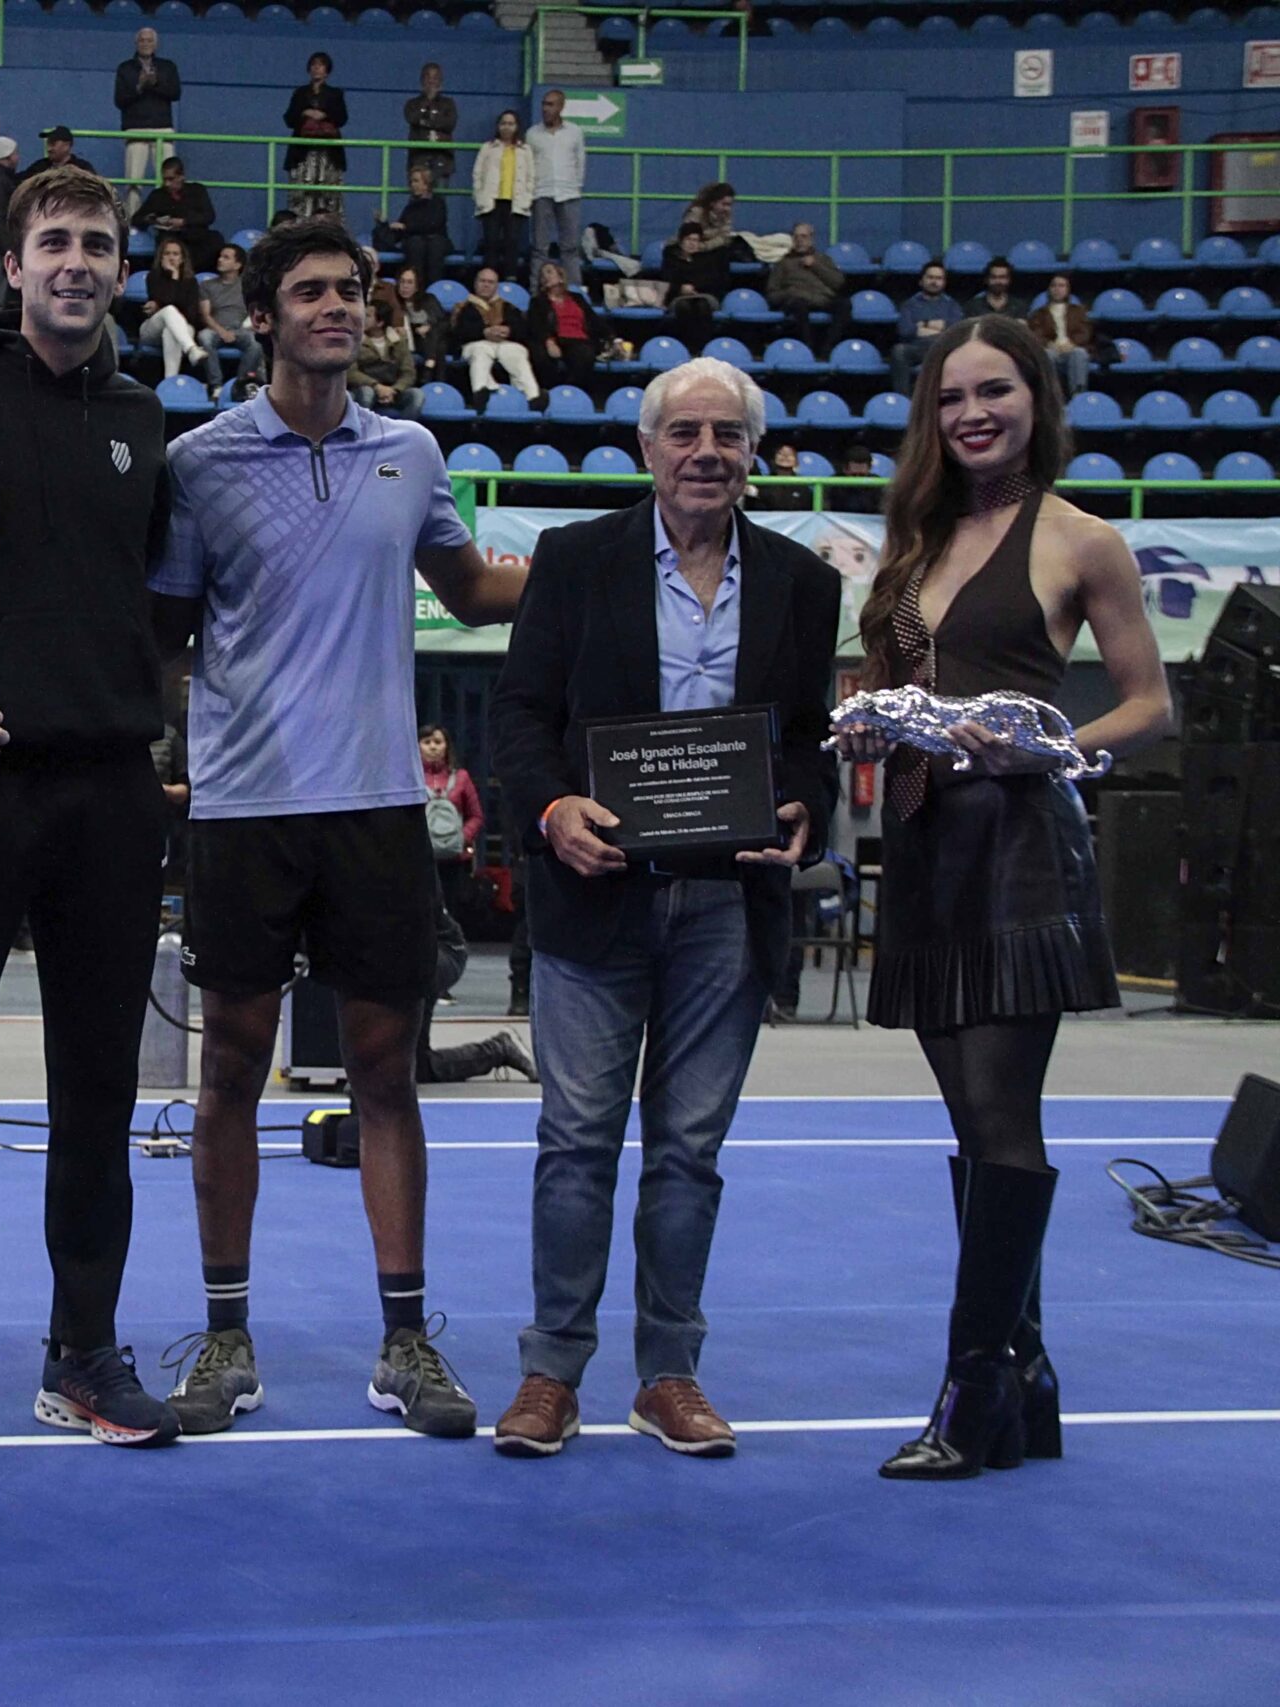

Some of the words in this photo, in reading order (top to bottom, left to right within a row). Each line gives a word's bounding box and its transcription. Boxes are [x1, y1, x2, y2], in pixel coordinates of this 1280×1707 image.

[610, 748, 638, 762] José
[641, 745, 684, 760] Ignacio
[687, 740, 746, 755] Escalante
[640, 762, 655, 773] de
[658, 761, 669, 772] la
[672, 757, 718, 771] Hidalga
